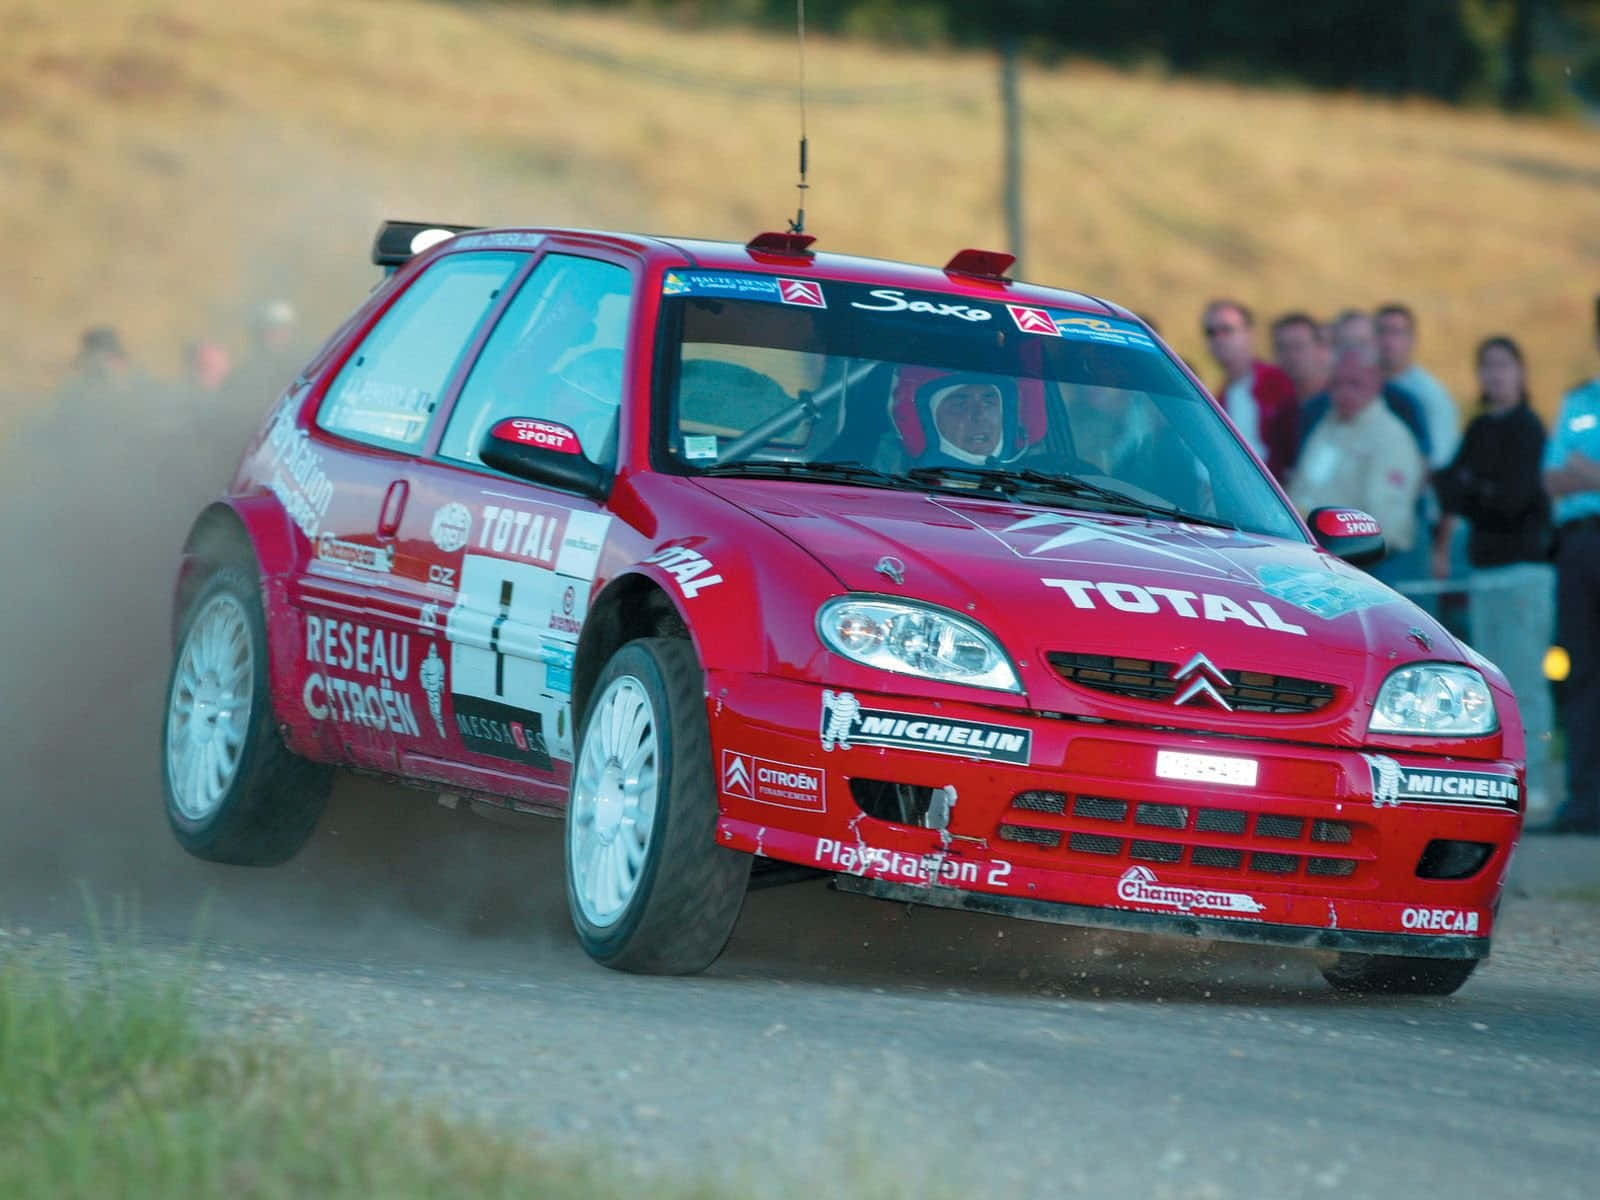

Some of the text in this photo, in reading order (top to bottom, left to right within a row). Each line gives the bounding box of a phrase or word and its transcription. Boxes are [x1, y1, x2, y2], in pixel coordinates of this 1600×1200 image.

[850, 290, 992, 321] Saxo
[517, 429, 565, 447] SPORT
[478, 505, 558, 563] TOTAL
[429, 565, 456, 585] OZ
[1040, 577, 1308, 636] TOTAL
[306, 615, 409, 681] RESEAU
[303, 673, 420, 737] CITROËN
[859, 715, 1025, 752] MICHELIN
[758, 768, 817, 790] CITROËN
[1407, 774, 1519, 800] MICHELIN
[987, 860, 1012, 887] 2
[1122, 880, 1231, 908] Champeau
[1401, 908, 1464, 931] ORECA
